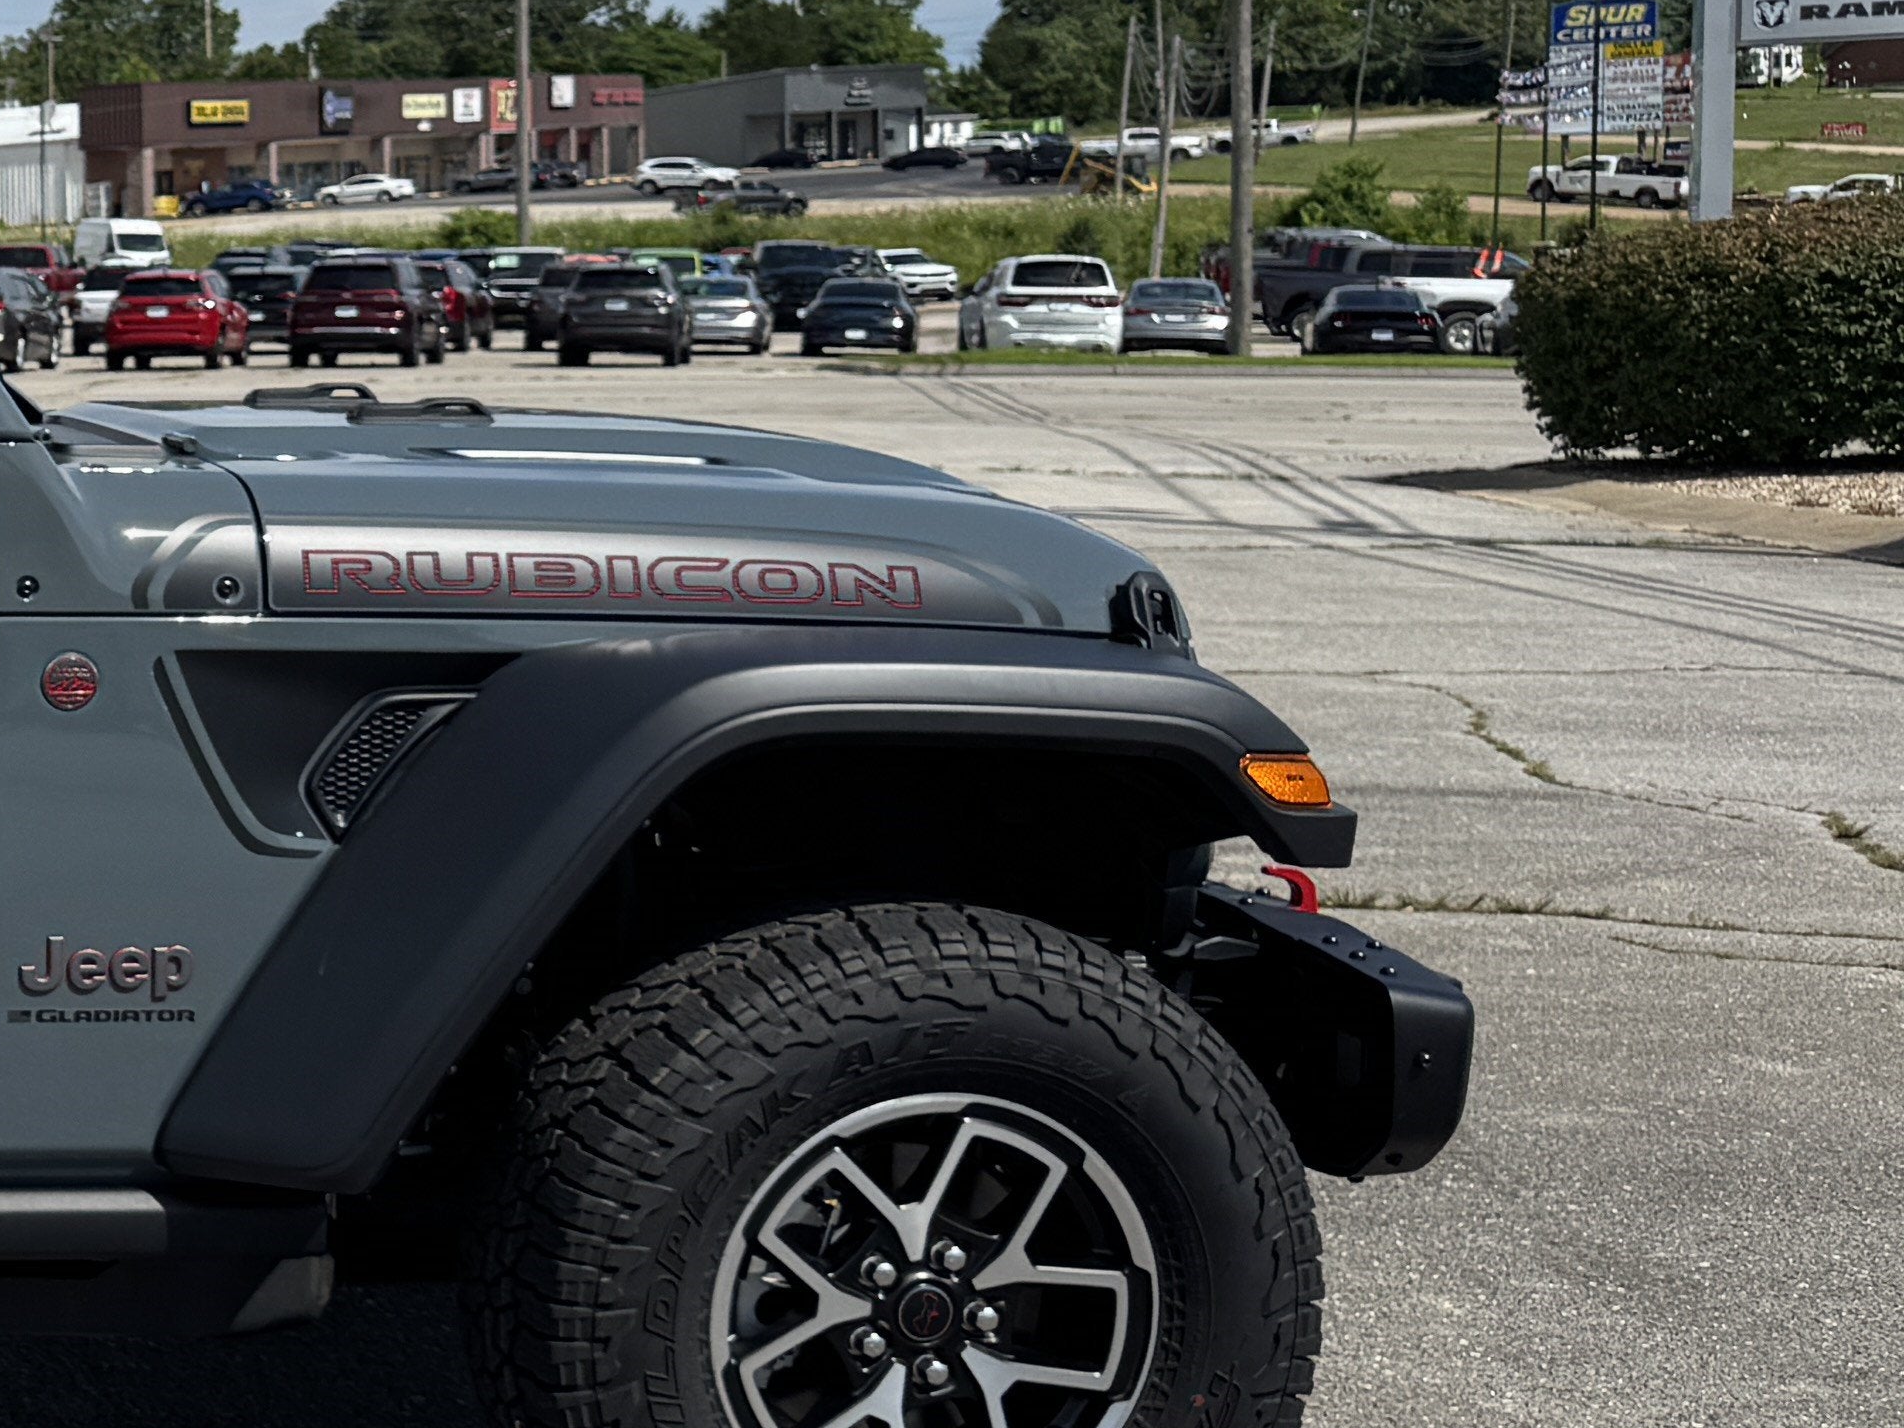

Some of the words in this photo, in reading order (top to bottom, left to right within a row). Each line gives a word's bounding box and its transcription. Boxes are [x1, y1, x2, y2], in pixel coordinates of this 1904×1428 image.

[1799, 0, 1904, 20] RAM
[301, 548, 923, 609] RUBICON
[17, 934, 194, 1003] Jeep
[34, 1008, 196, 1024] GLADIATOR
